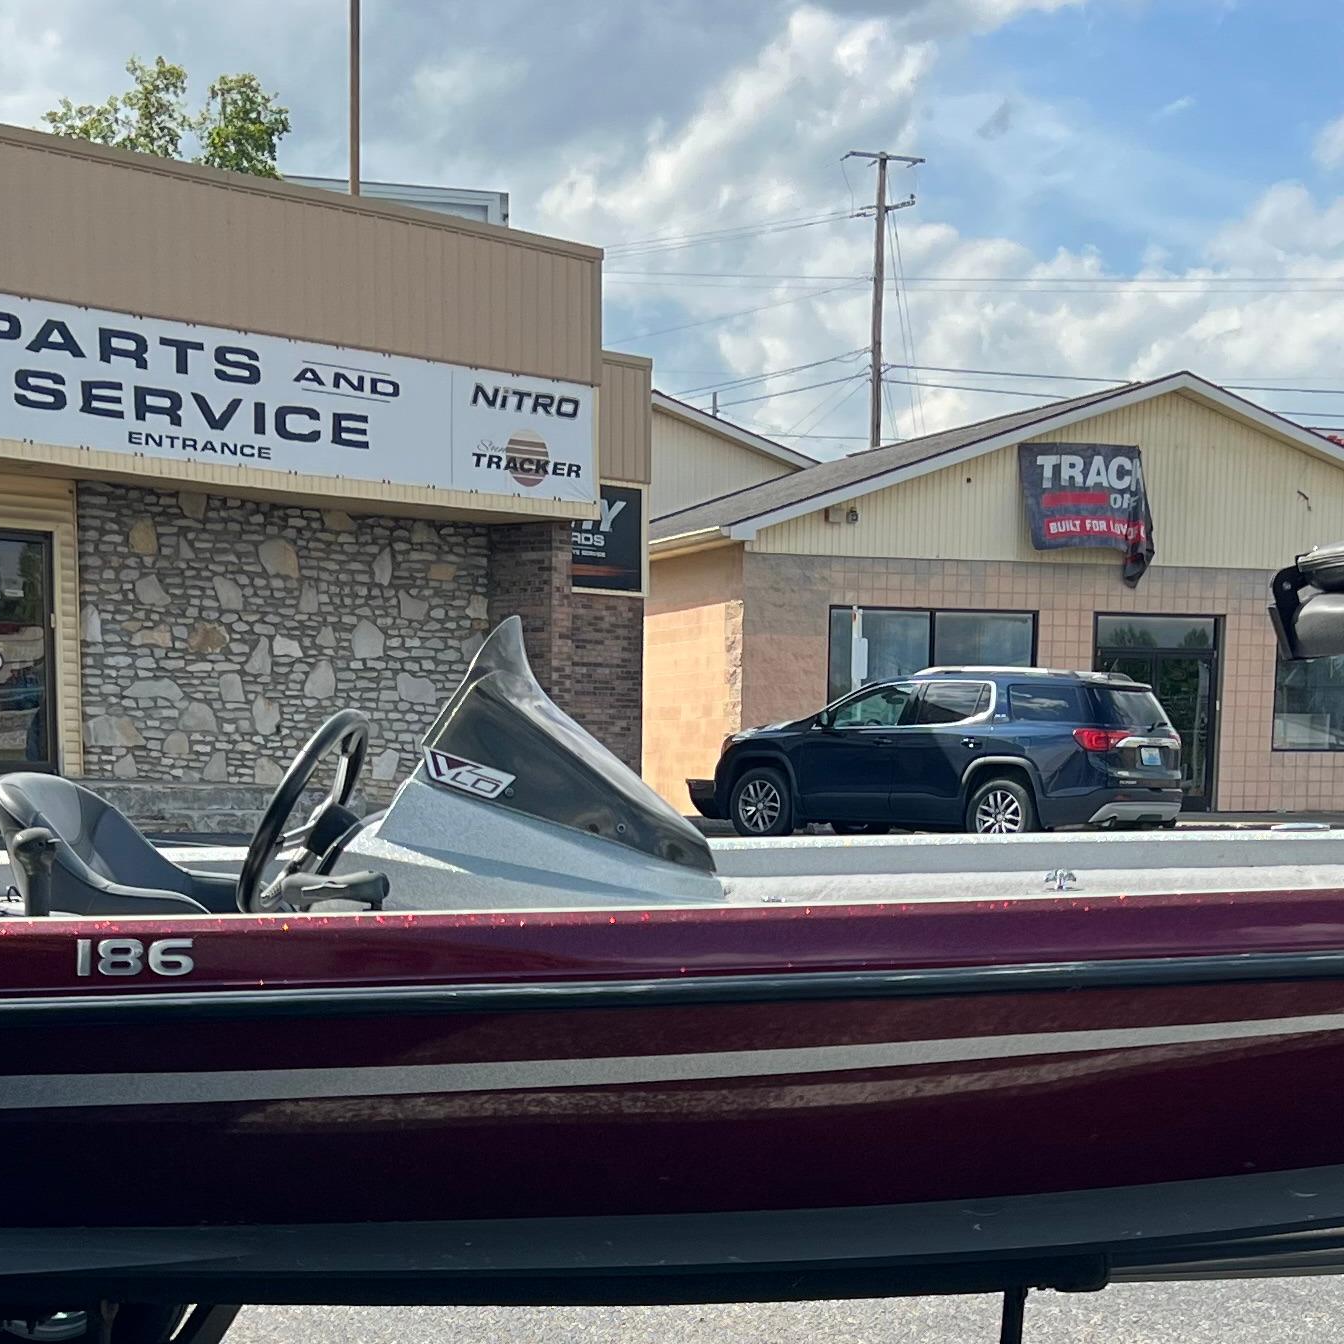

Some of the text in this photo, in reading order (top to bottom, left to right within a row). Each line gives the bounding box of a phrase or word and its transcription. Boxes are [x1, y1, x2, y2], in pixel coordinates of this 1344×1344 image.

[293, 367, 400, 398] AND
[13, 368, 370, 449] SERVICE
[127, 430, 272, 460] ENTRANCE
[471, 452, 582, 479] TRACKER
[1036, 455, 1145, 492] TRACK
[571, 532, 605, 547] ADS
[1049, 519, 1081, 534] BUILT
[1085, 519, 1108, 532] FOR
[76, 938, 194, 977] 186
